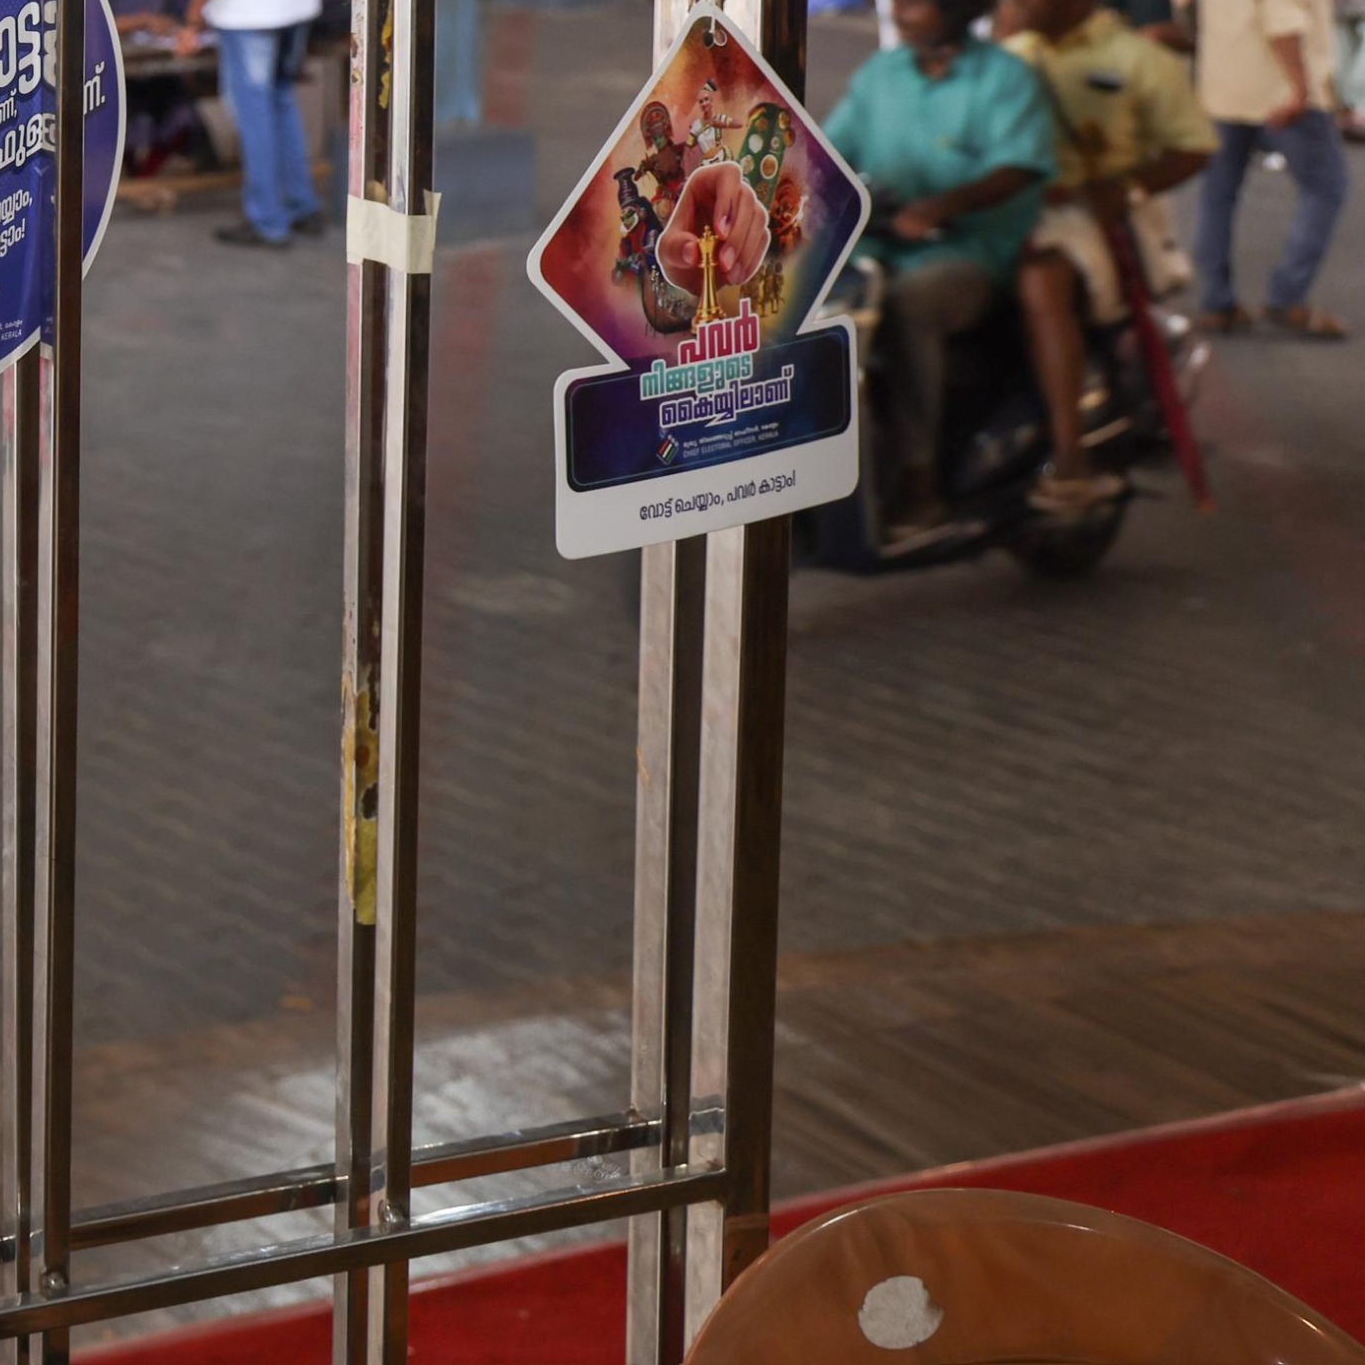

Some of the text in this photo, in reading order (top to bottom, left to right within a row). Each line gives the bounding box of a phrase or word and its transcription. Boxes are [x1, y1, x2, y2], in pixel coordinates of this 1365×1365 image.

[679, 299, 759, 365] പവർ
[639, 498, 673, 520] വോട്ട്
[727, 480, 756, 502] പവർ
